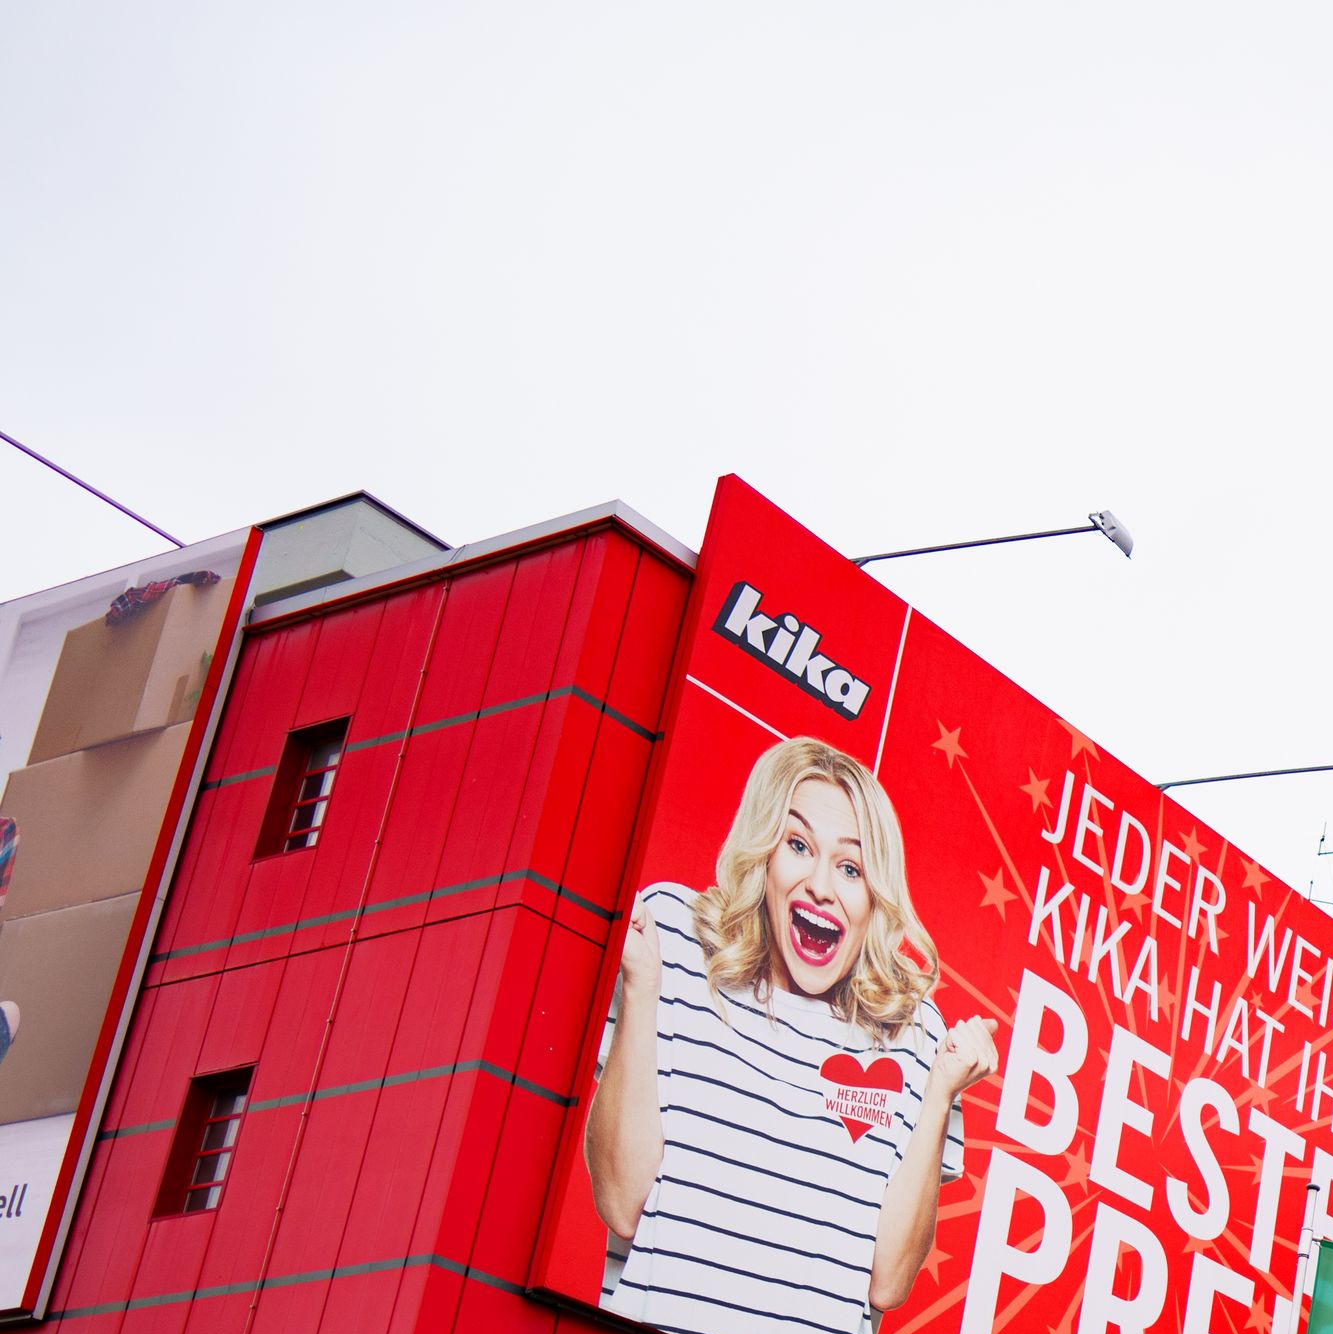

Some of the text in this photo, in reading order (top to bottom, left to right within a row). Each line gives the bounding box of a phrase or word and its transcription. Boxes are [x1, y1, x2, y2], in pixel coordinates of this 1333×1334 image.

[712, 580, 871, 720] kika
[1041, 769, 1227, 957] JEDER
[1028, 865, 1159, 1023] KIKA
[1181, 966, 1285, 1088] HAT
[825, 1097, 893, 1129] WILLKOMMEN
[837, 1087, 887, 1108] HERZLICH
